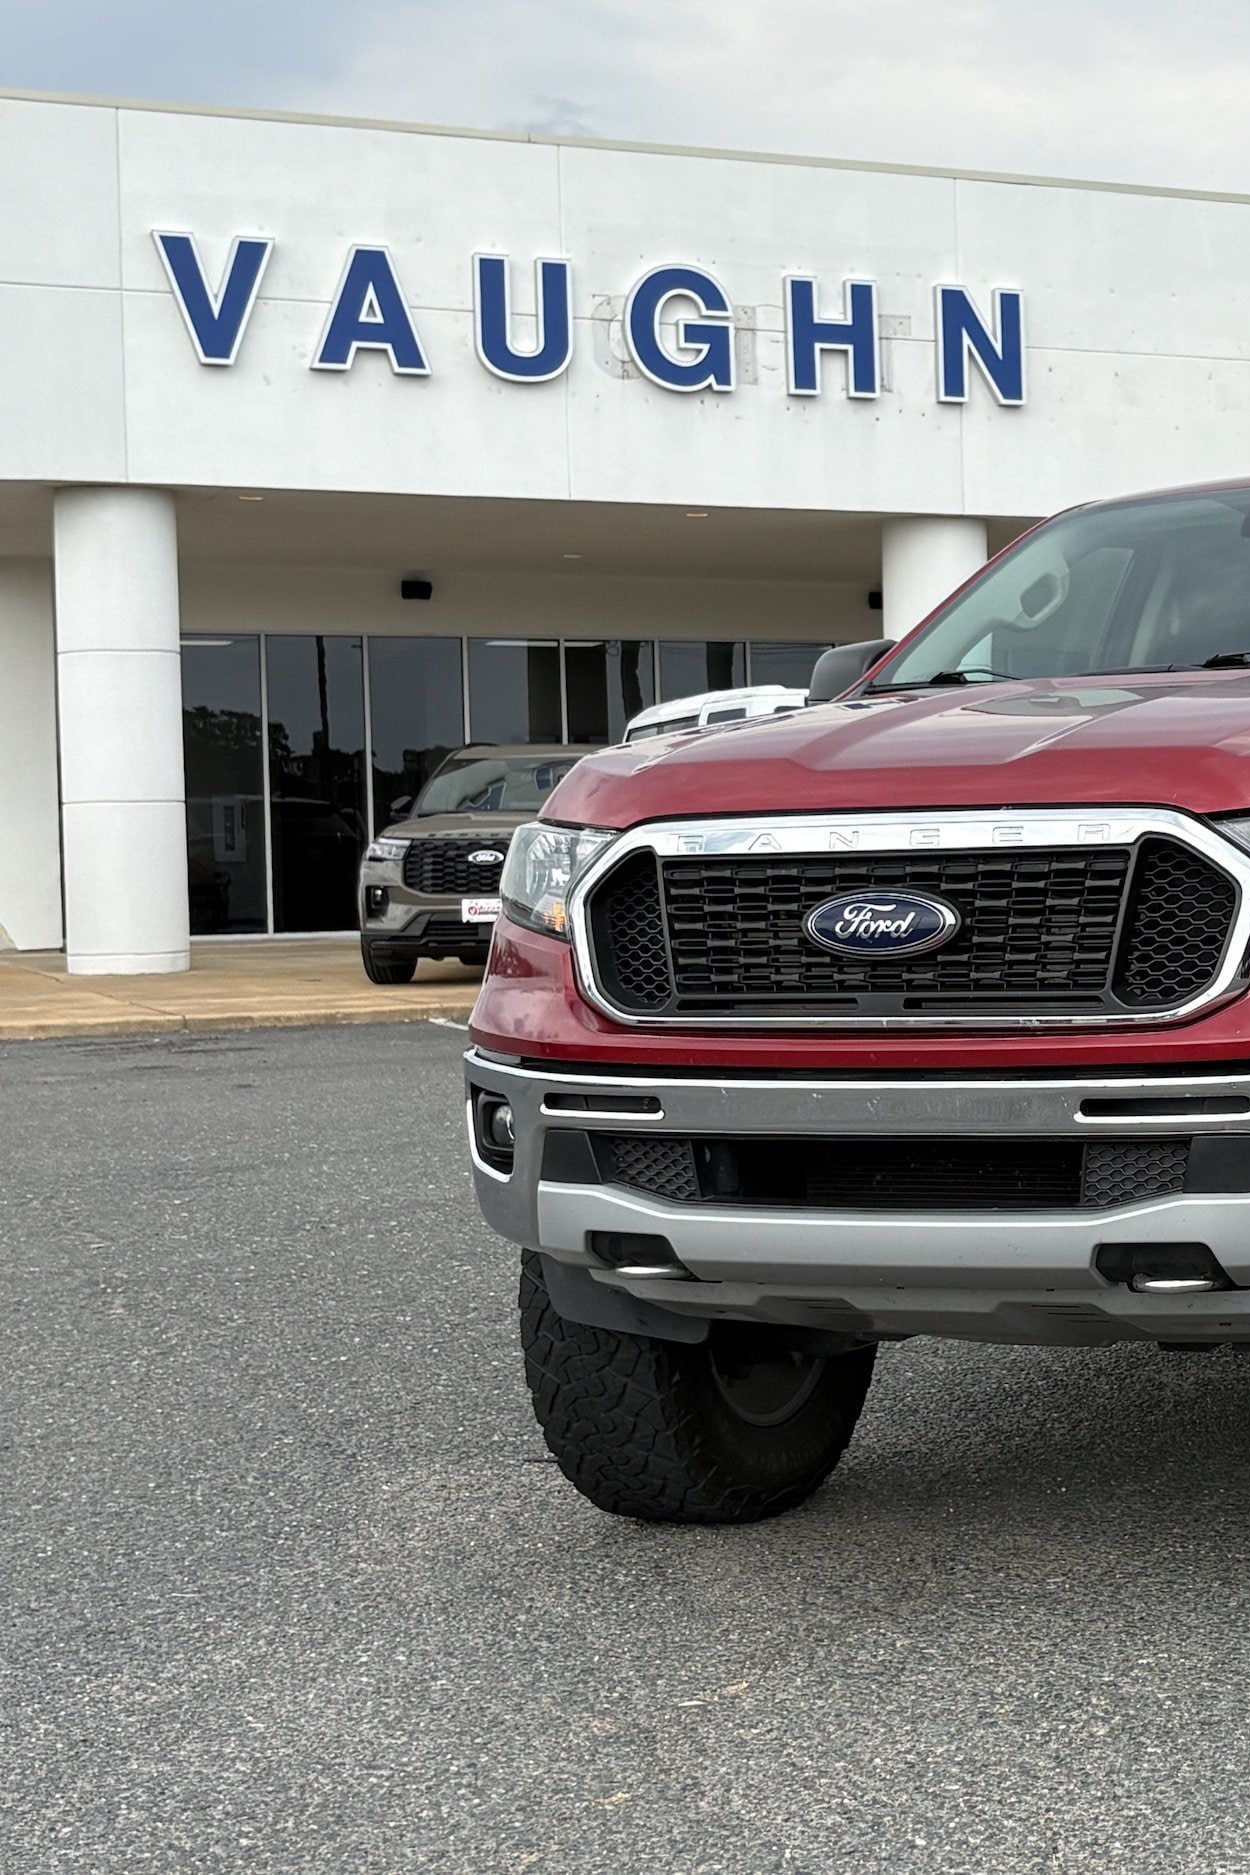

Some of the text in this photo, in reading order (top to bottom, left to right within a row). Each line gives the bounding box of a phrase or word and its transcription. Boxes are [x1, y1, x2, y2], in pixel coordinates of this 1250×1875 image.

[151, 229, 1027, 407] VAUGHN
[677, 823, 1111, 853] RANGER
[834, 903, 916, 939] Ford
